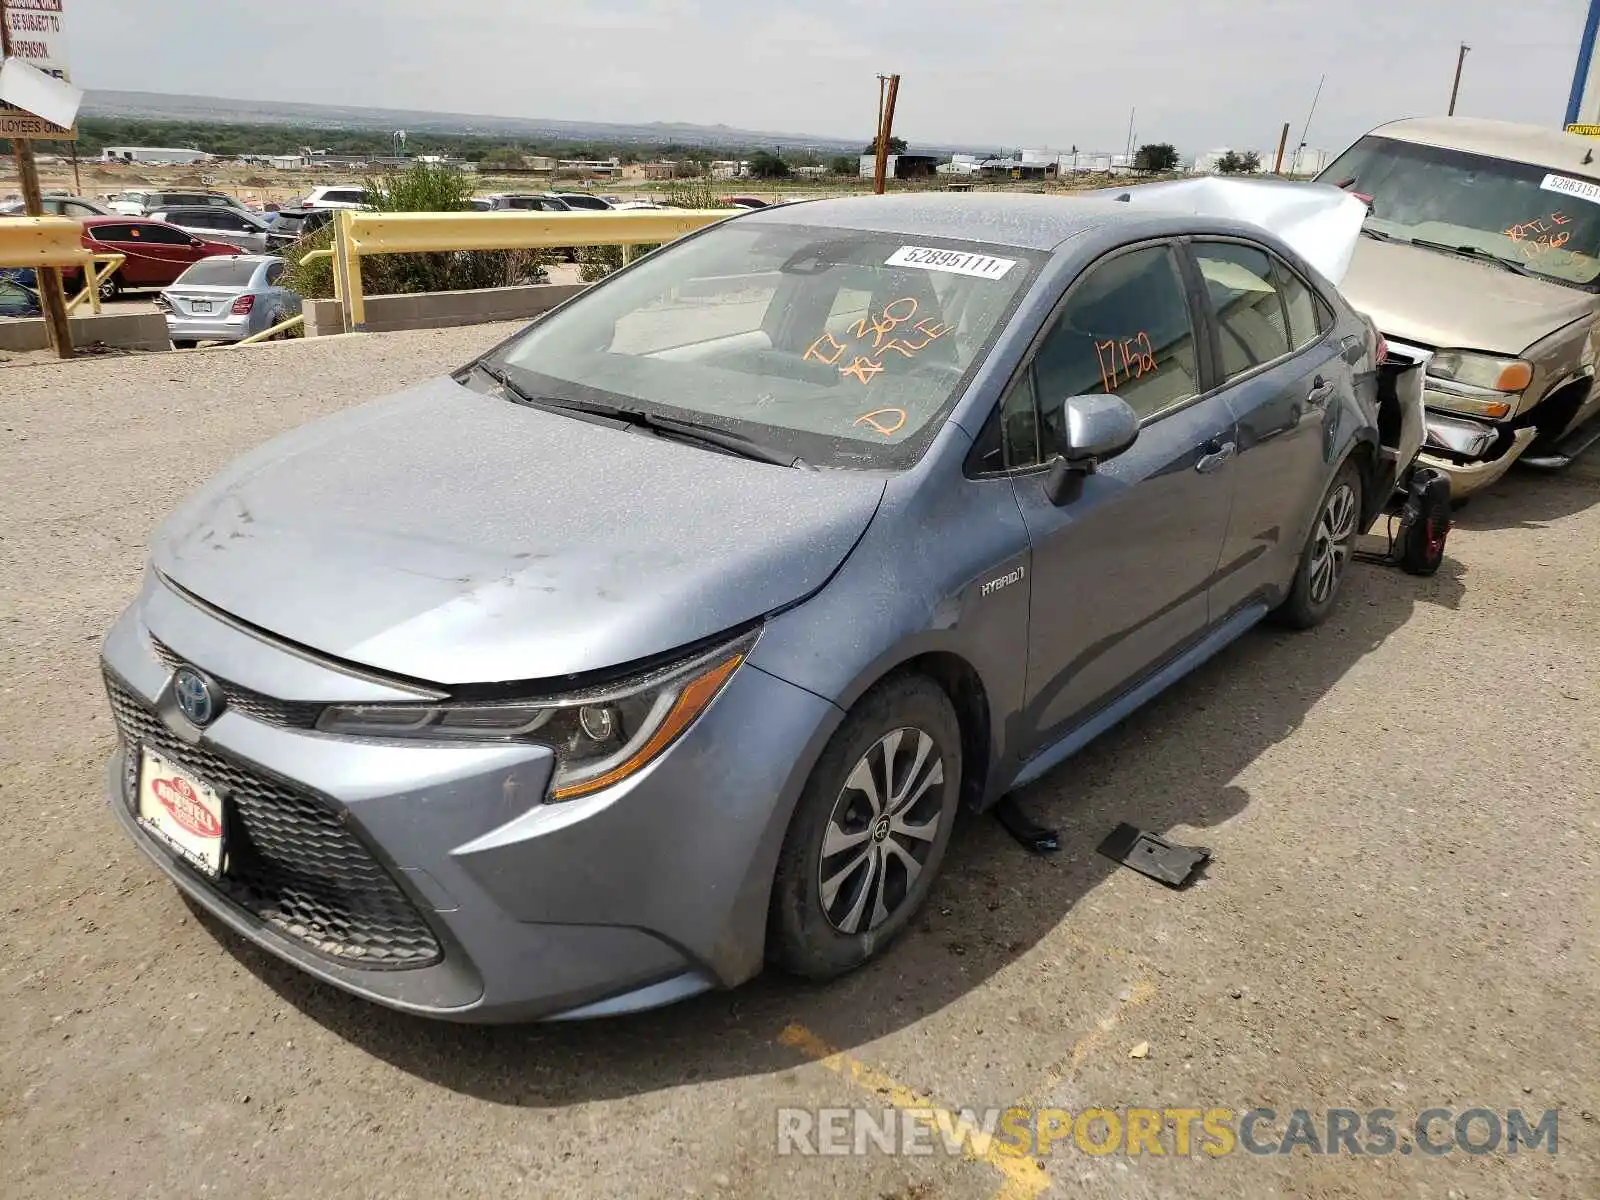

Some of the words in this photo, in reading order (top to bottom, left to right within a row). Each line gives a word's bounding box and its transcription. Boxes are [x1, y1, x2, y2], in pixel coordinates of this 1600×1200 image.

[12, 13, 21, 30] BE
[22, 13, 49, 32] SUBJECT
[50, 15, 60, 33] TO
[1094, 331, 1158, 393] 17152
[981, 566, 1024, 597] HYBRID
